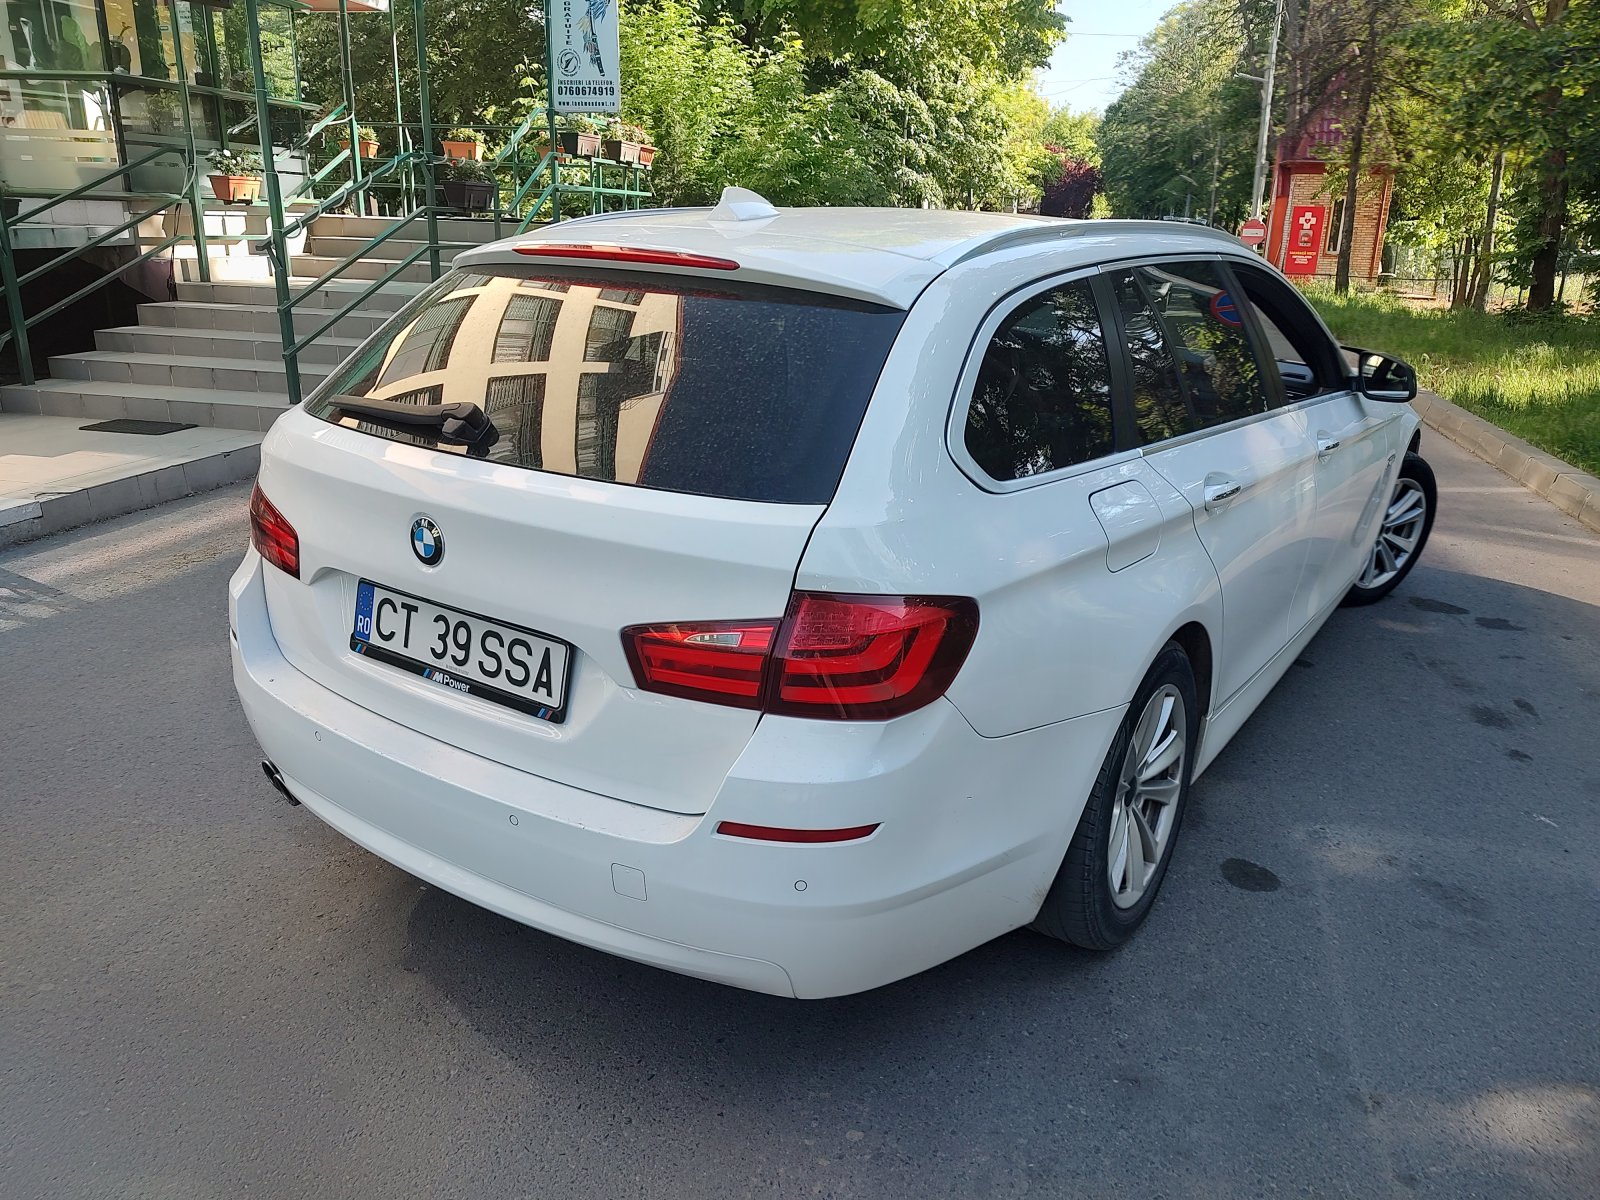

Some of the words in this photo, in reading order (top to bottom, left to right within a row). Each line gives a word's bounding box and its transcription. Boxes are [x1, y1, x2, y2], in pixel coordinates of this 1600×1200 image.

[563, 1, 572, 46] GRATUITE
[557, 86, 615, 96] 0760674919
[357, 614, 371, 635] RO
[375, 597, 419, 649] CT
[430, 613, 472, 667] 39
[478, 629, 553, 699] SSA
